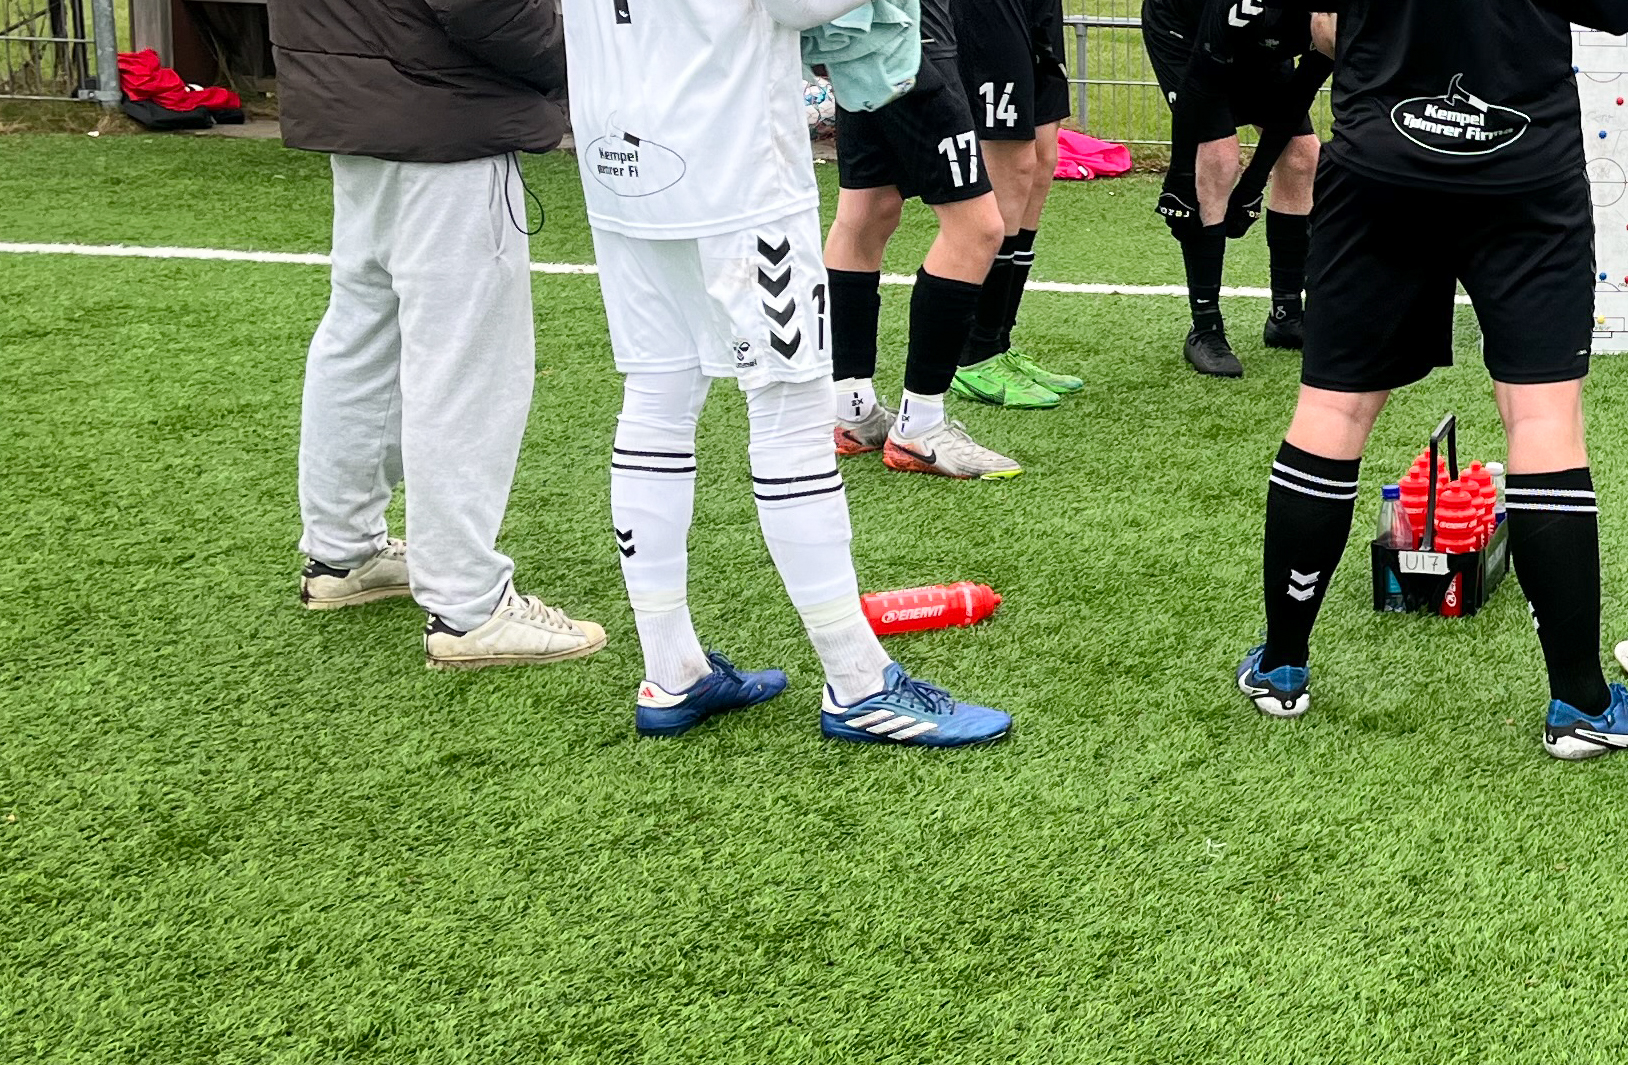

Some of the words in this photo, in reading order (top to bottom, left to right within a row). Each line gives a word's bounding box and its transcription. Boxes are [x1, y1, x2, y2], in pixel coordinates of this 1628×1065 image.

[979, 82, 1018, 127] 14
[1424, 103, 1485, 126] Kempel
[938, 130, 978, 187] 17
[812, 284, 825, 350] 1
[1406, 555, 1439, 572] U17
[898, 604, 946, 621] ENERVIT
